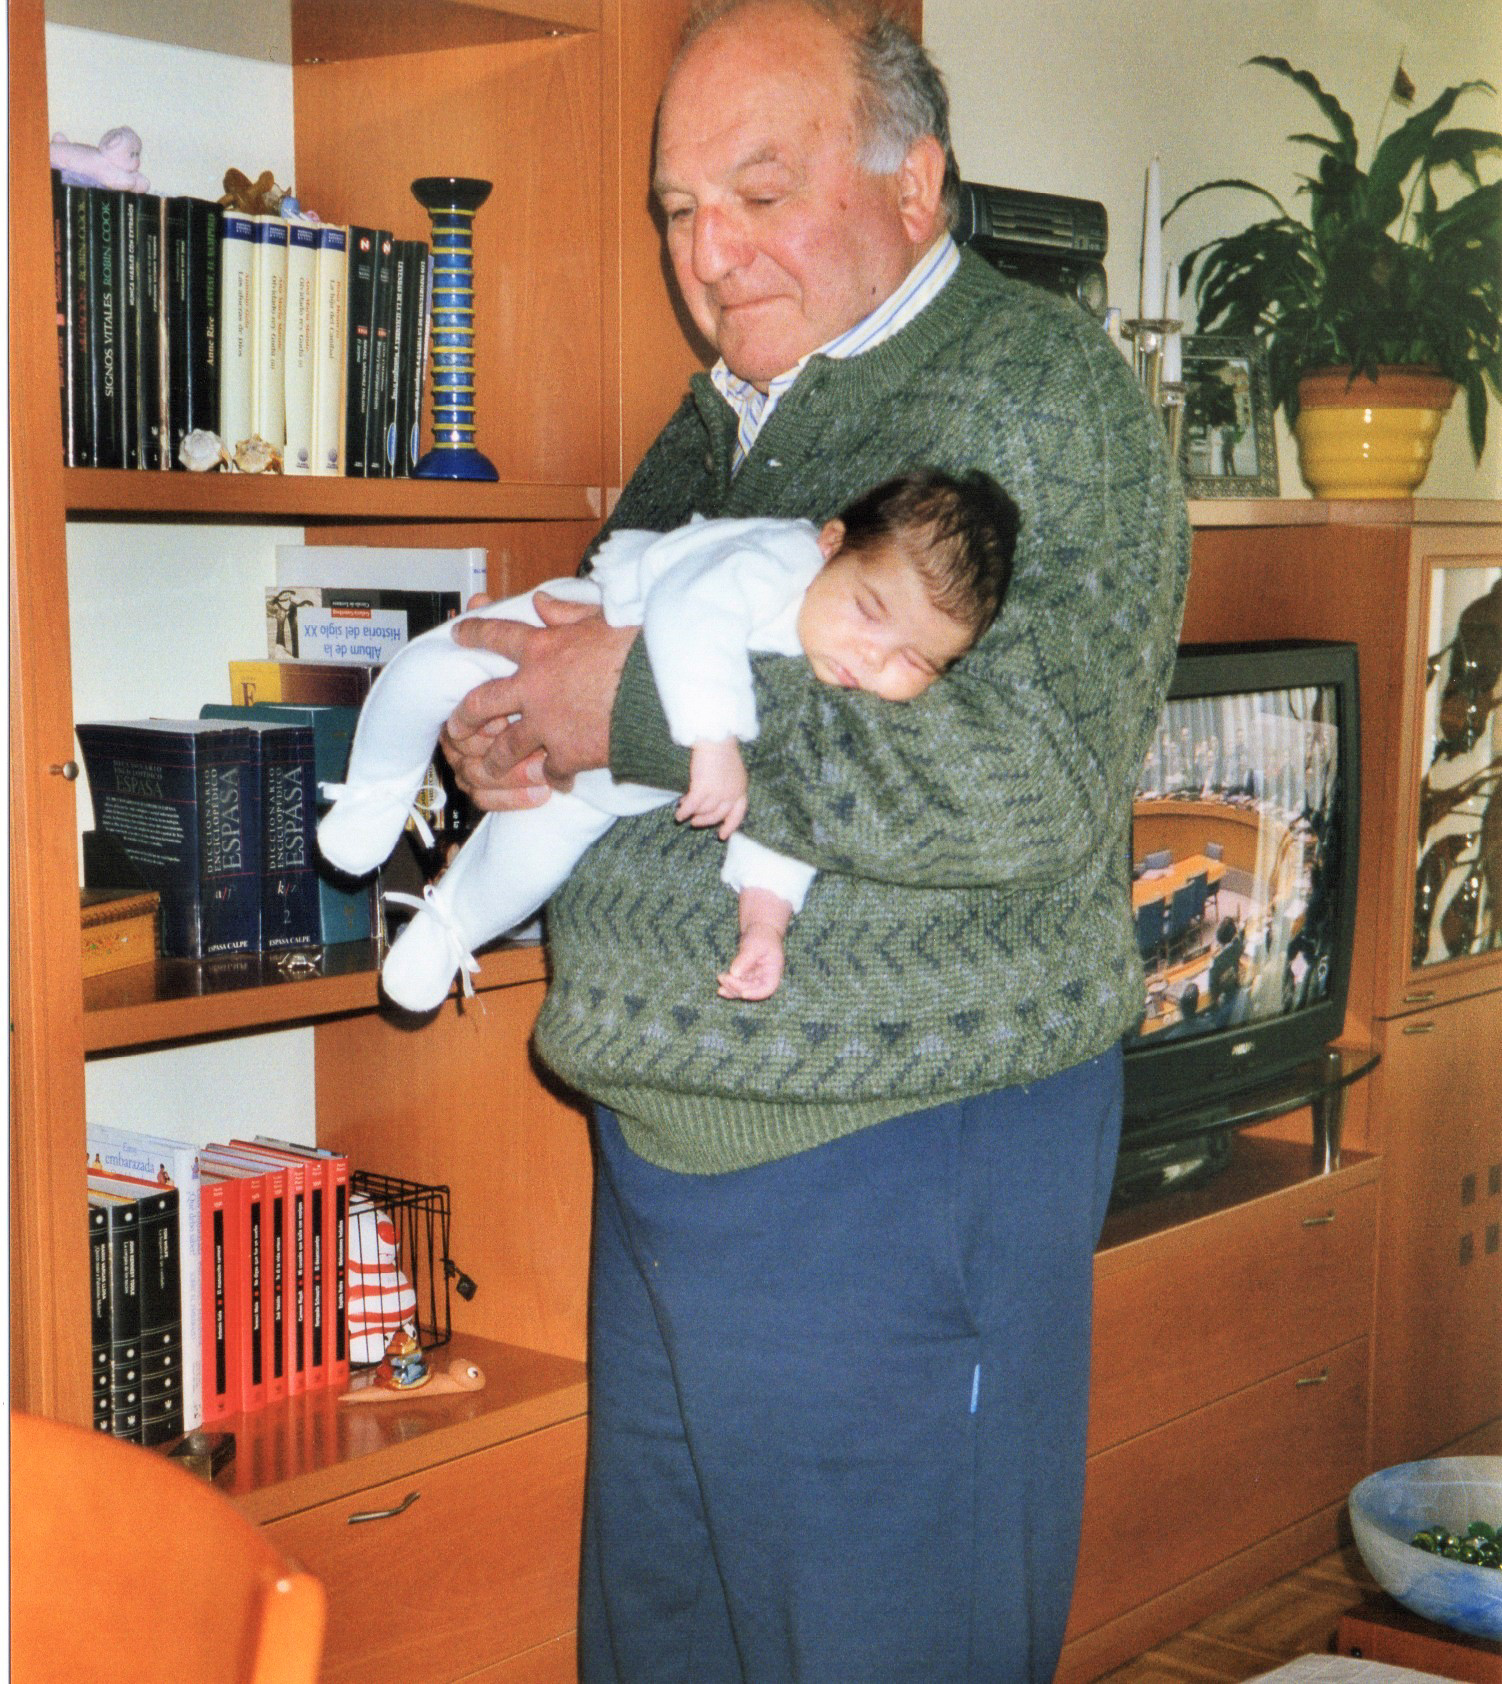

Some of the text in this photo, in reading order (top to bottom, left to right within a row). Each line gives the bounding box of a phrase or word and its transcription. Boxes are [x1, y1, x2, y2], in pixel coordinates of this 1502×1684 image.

[329, 279, 336, 291] La
[101, 203, 114, 397] SIGNOS VITALES ROBIN COOK
[328, 293, 336, 310] hija
[396, 293, 403, 302] DE
[396, 302, 403, 311] LA
[206, 315, 215, 338] Rice
[237, 324, 244, 335] de
[417, 318, 424, 327] DE
[417, 327, 424, 336] LA
[206, 340, 215, 367] Anne
[415, 336, 423, 360] VIRTUD
[304, 623, 401, 641] Historia del siglo XX
[324, 644, 333, 657] la
[335, 644, 348, 656] de
[116, 775, 164, 800] ESPASA
[204, 769, 213, 873] DICCIONARIO
[219, 768, 242, 870] ESPASA
[282, 766, 305, 866] ESPASA
[283, 909, 292, 924] 2
[208, 940, 248, 953] ESPASA CALPE
[269, 935, 310, 947] ESPASA CALPE
[105, 1151, 155, 1174] embarazada
